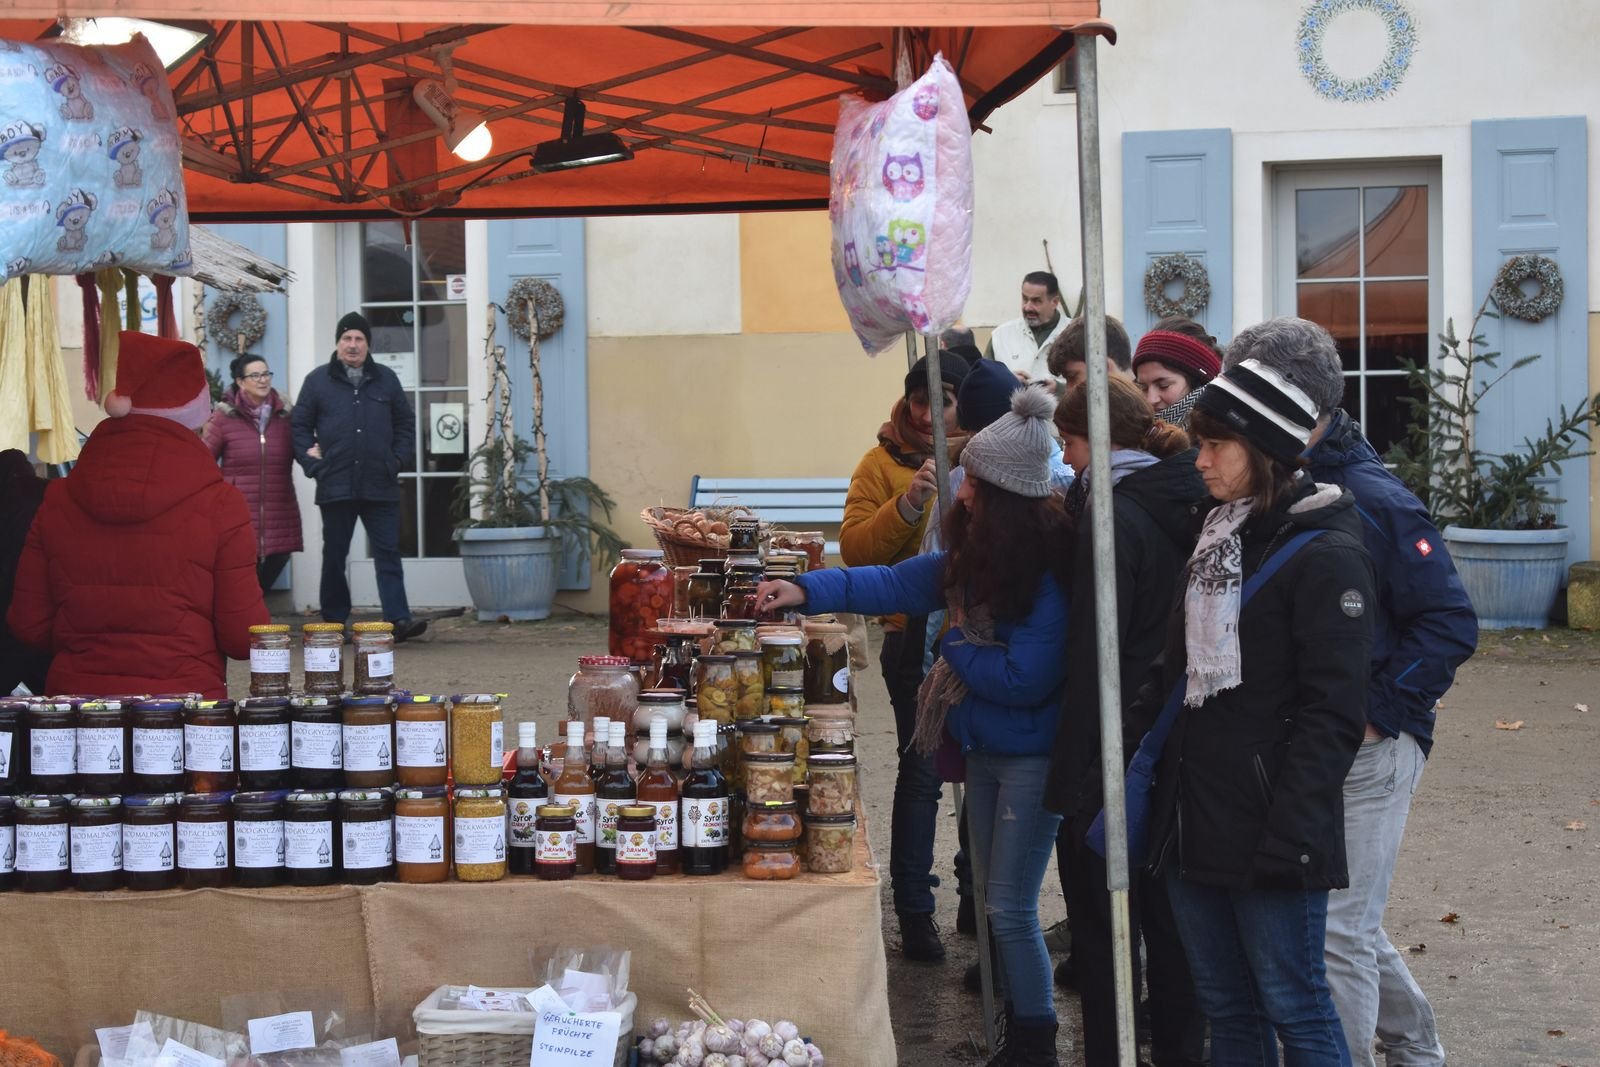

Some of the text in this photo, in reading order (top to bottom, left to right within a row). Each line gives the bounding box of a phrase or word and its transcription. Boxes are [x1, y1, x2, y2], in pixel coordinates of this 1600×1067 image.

[0, 123, 24, 143] BOY
[552, 1026, 593, 1040] FRÜCHTE
[539, 1042, 596, 1058] STEINPILZE
